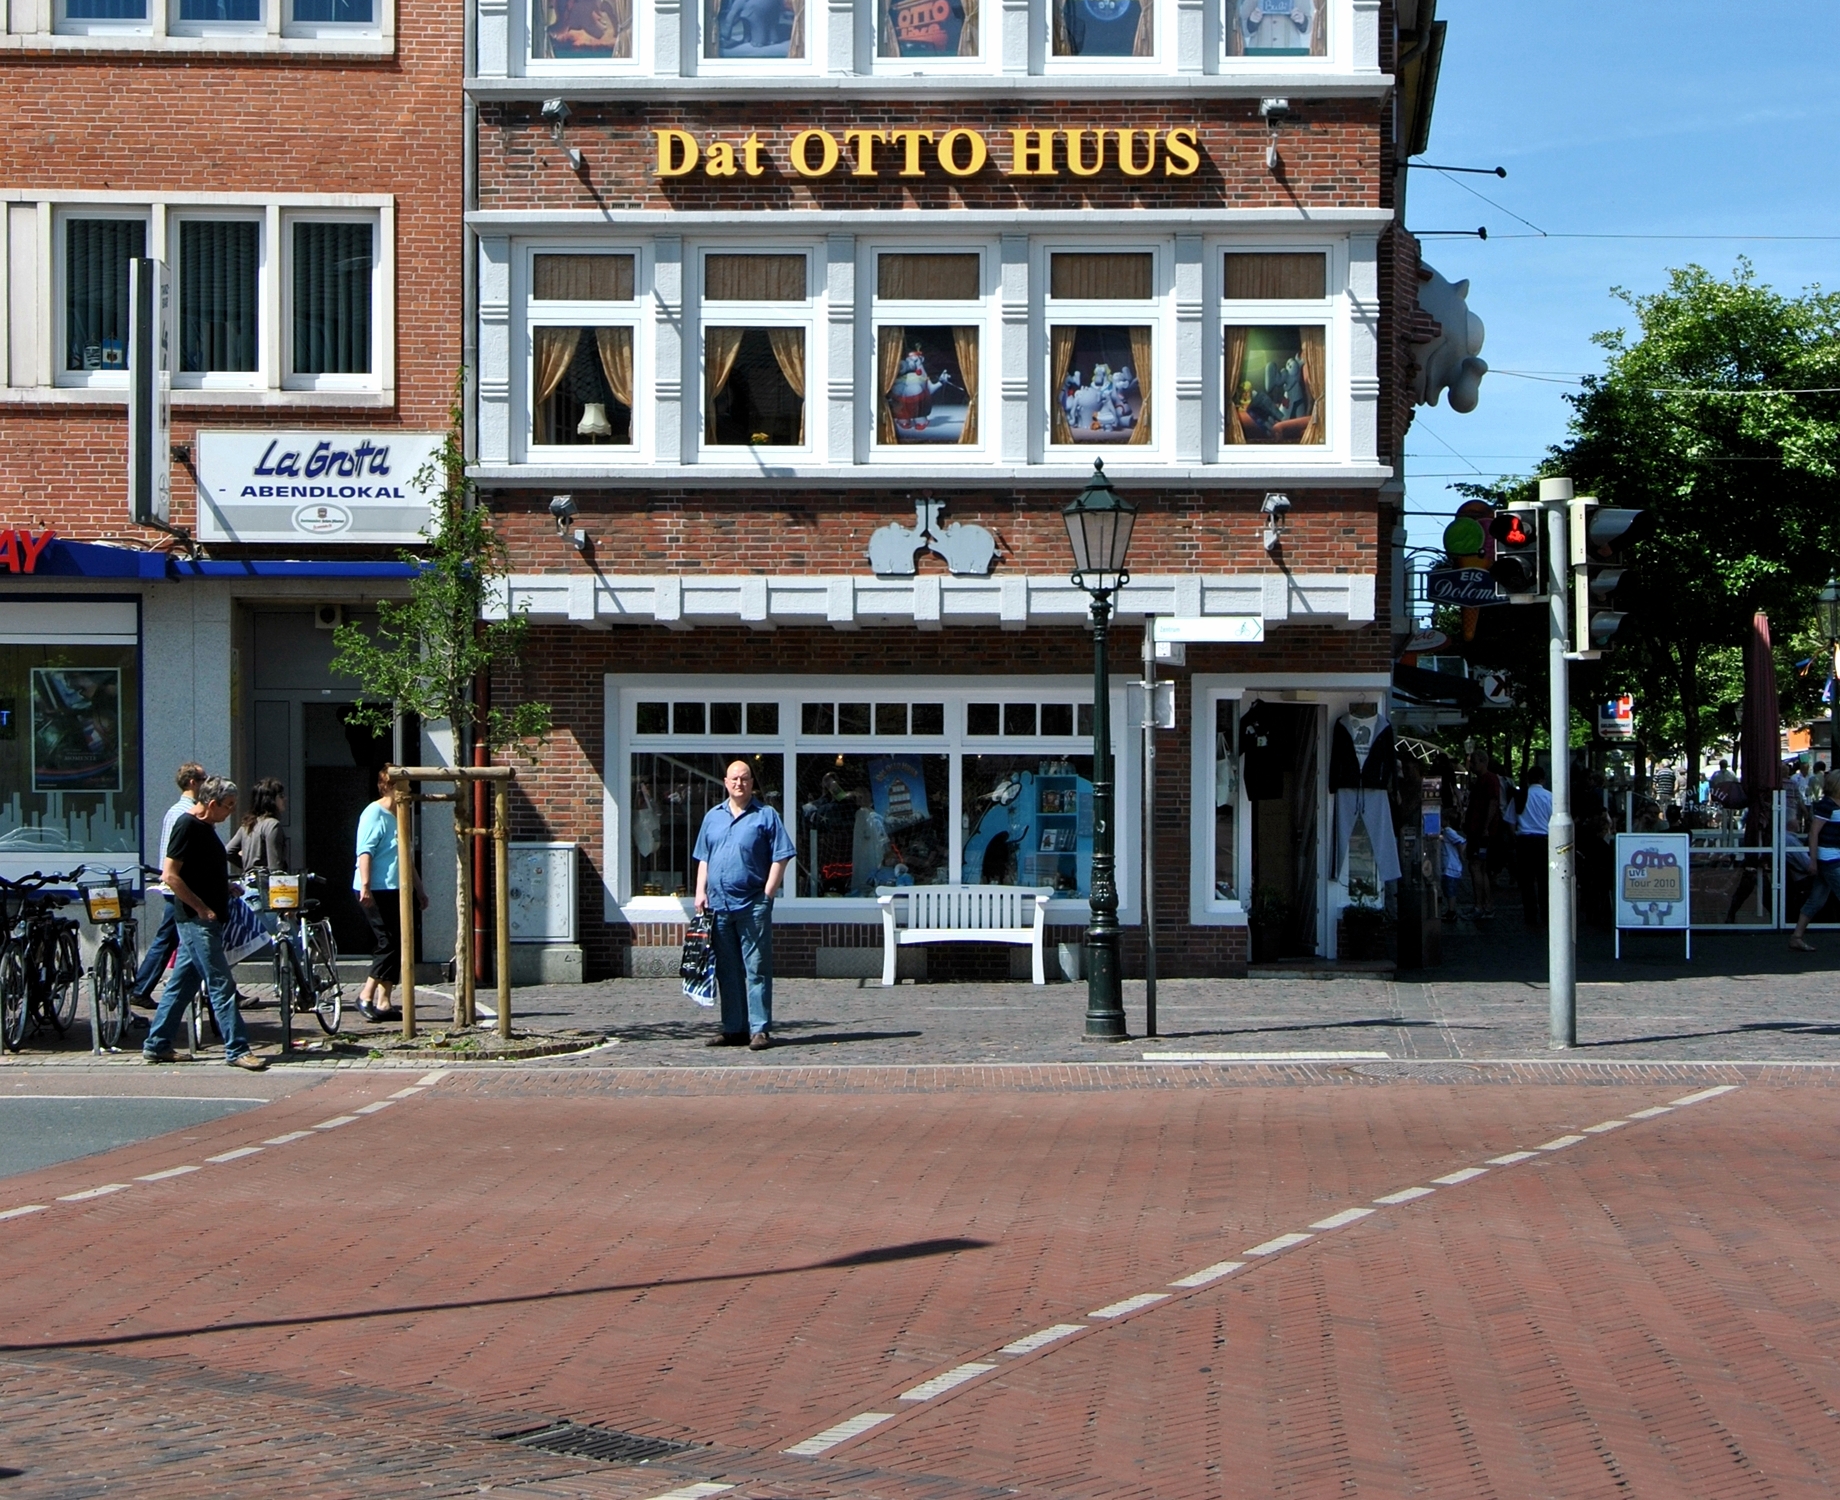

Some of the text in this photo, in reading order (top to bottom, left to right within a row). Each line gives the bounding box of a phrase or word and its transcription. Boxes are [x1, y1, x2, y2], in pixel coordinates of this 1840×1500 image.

[897, 0, 950, 29] OTTO
[652, 127, 1200, 178] Dat OTTO HUUS
[254, 438, 391, 478] La Grotta
[240, 485, 405, 499] ABENDLOKAL
[1460, 571, 1484, 583] EIS
[1434, 578, 1510, 600] Dolomi
[1630, 849, 1678, 870] OTTO
[1629, 869, 1646, 878] LIVE
[1629, 878, 1676, 888] Tour 2010
